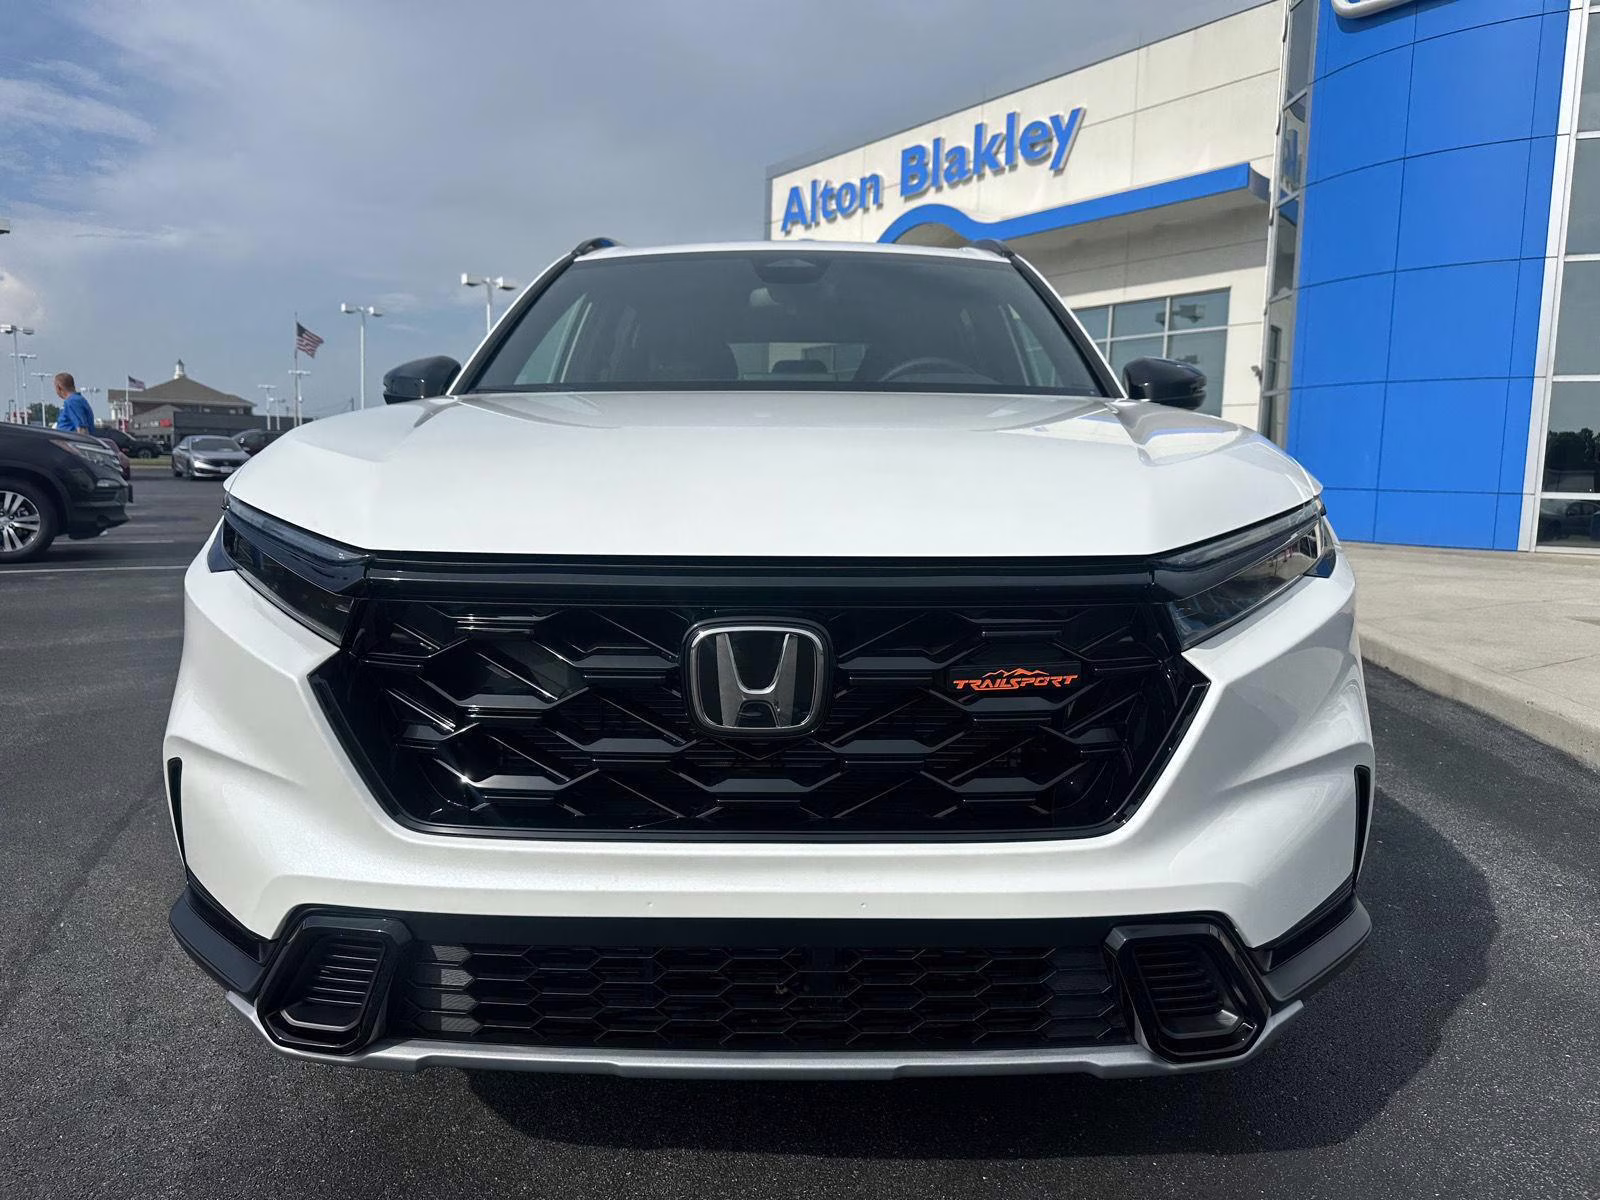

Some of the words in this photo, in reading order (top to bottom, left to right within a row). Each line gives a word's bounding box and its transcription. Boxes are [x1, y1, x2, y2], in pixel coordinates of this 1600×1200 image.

[781, 173, 882, 234] Alton
[900, 107, 1086, 199] Blakley
[952, 674, 1079, 692] TRAILSPORT
